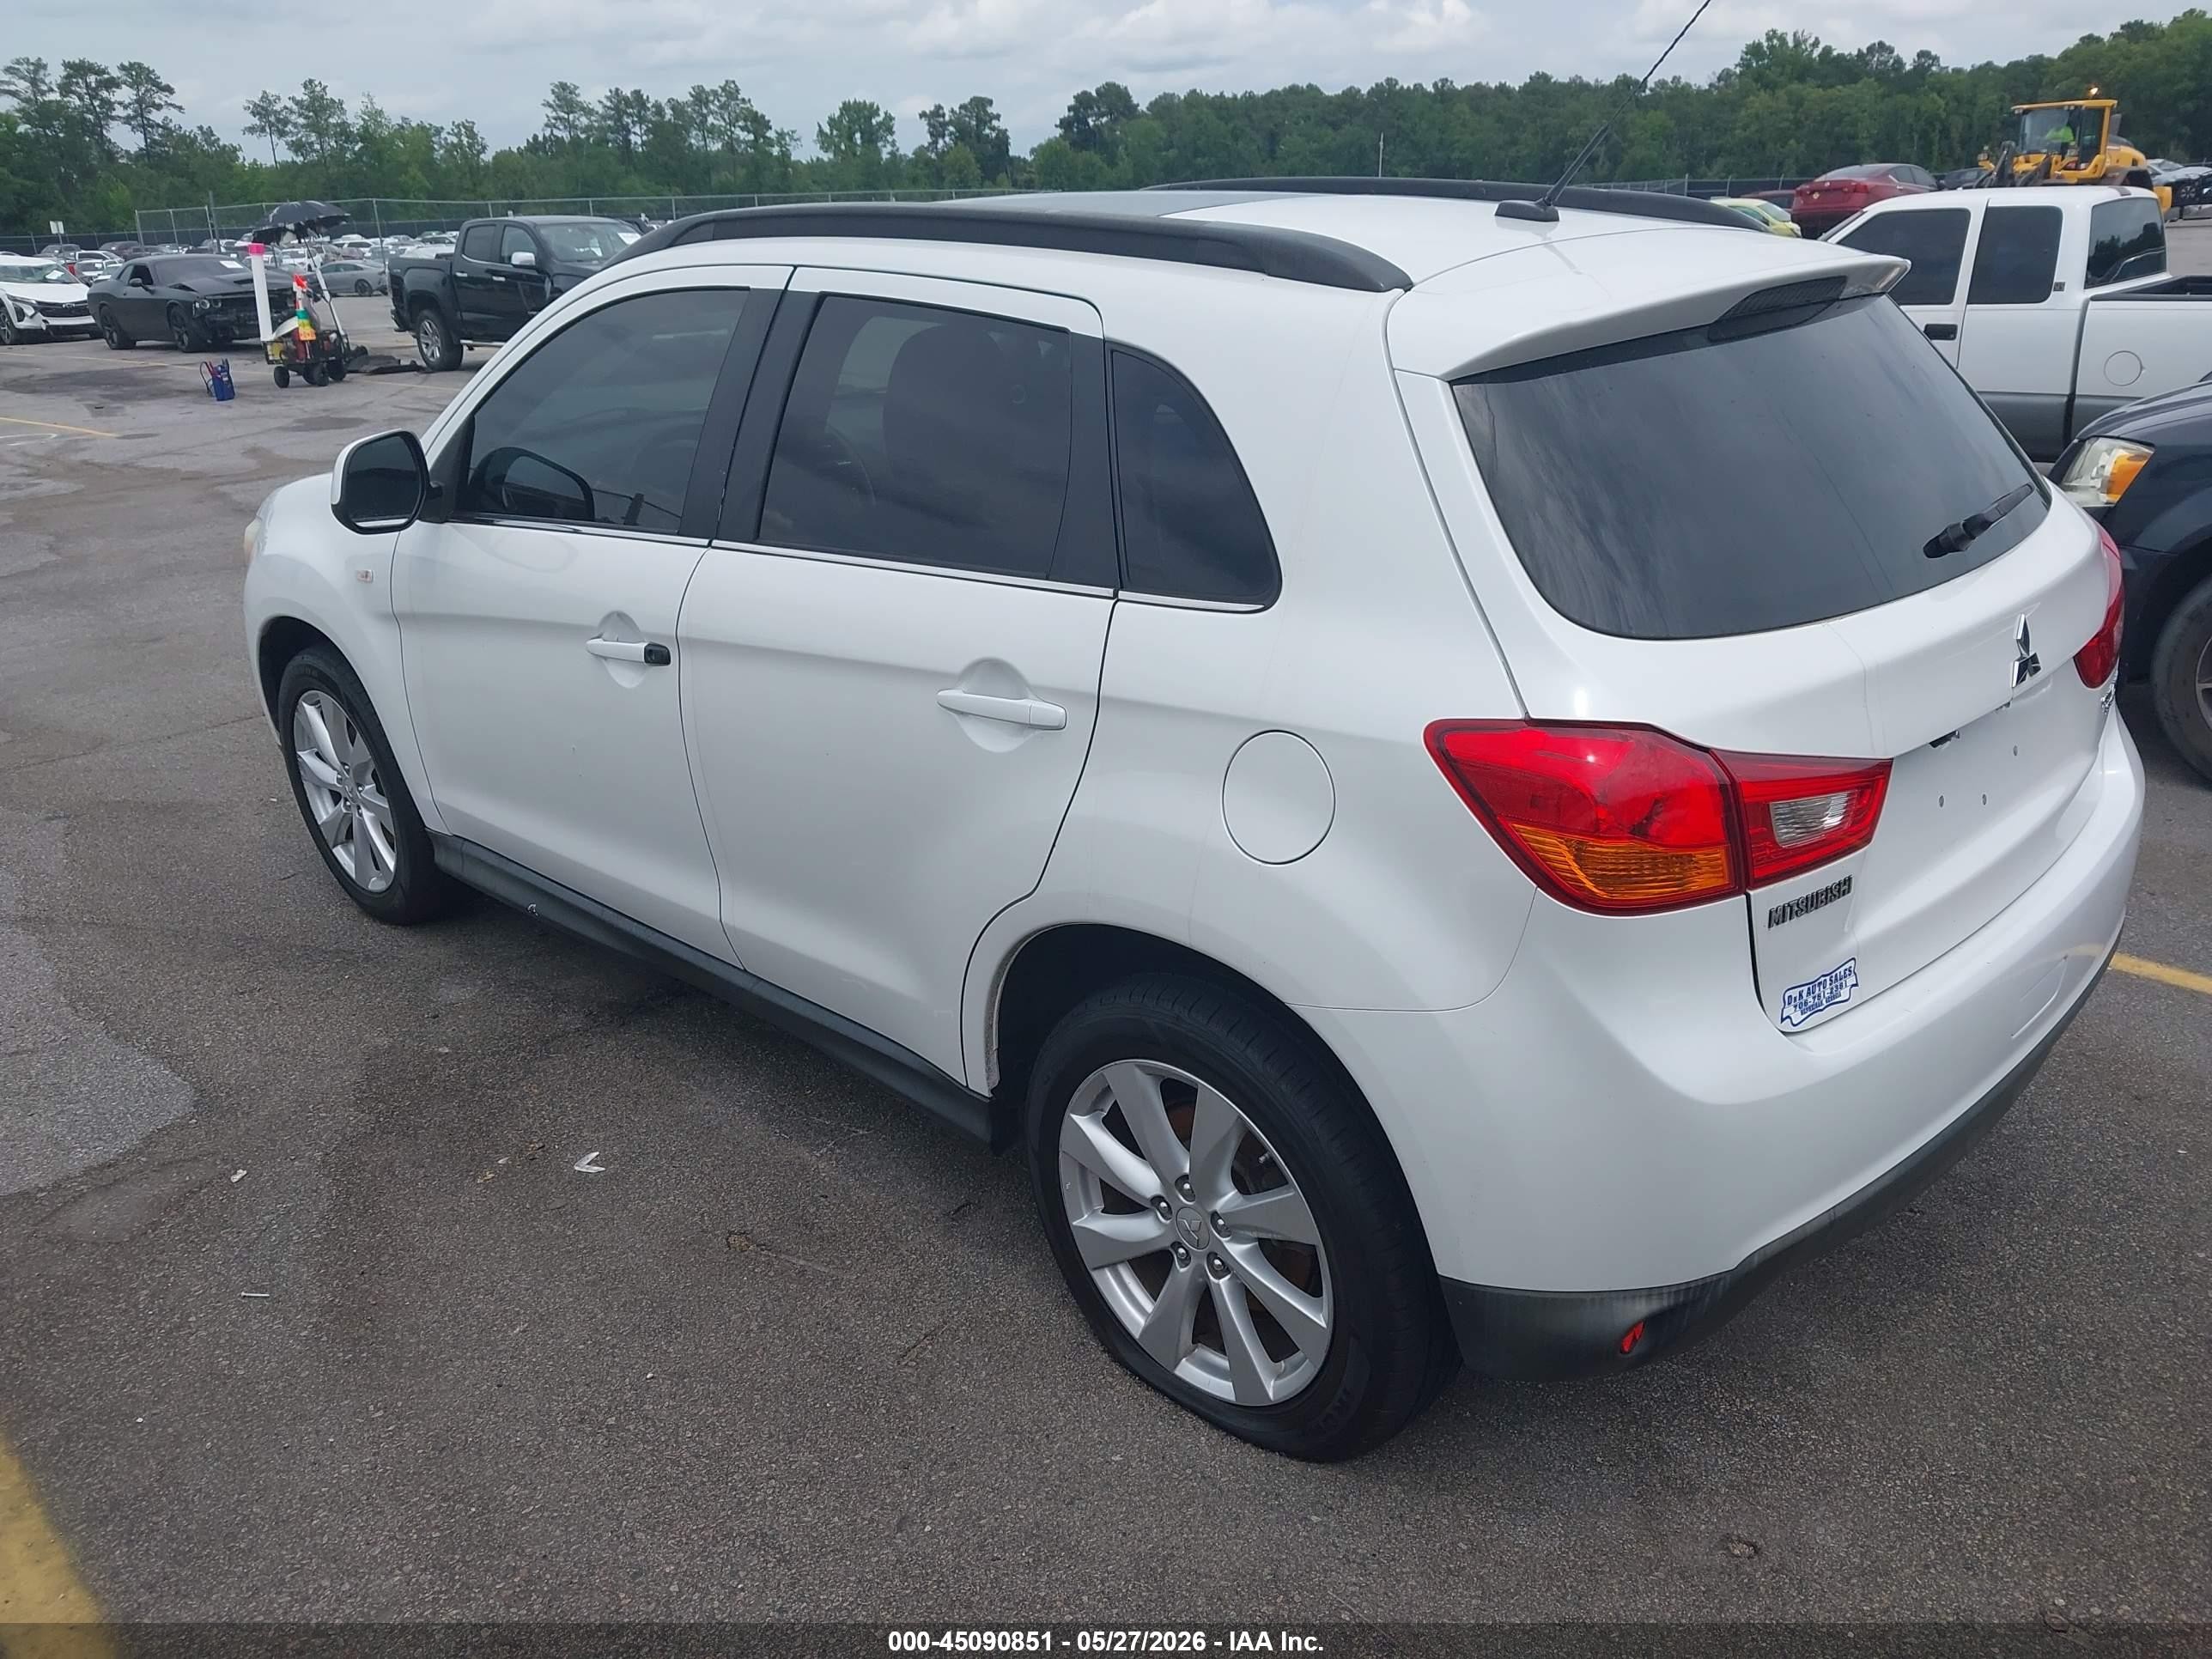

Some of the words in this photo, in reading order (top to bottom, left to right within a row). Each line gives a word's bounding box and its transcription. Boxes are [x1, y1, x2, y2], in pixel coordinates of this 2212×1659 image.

[1767, 874, 1853, 929] MITSUBISHI
[1807, 978, 1827, 998] AUTO
[1829, 965, 1852, 987] SALES
